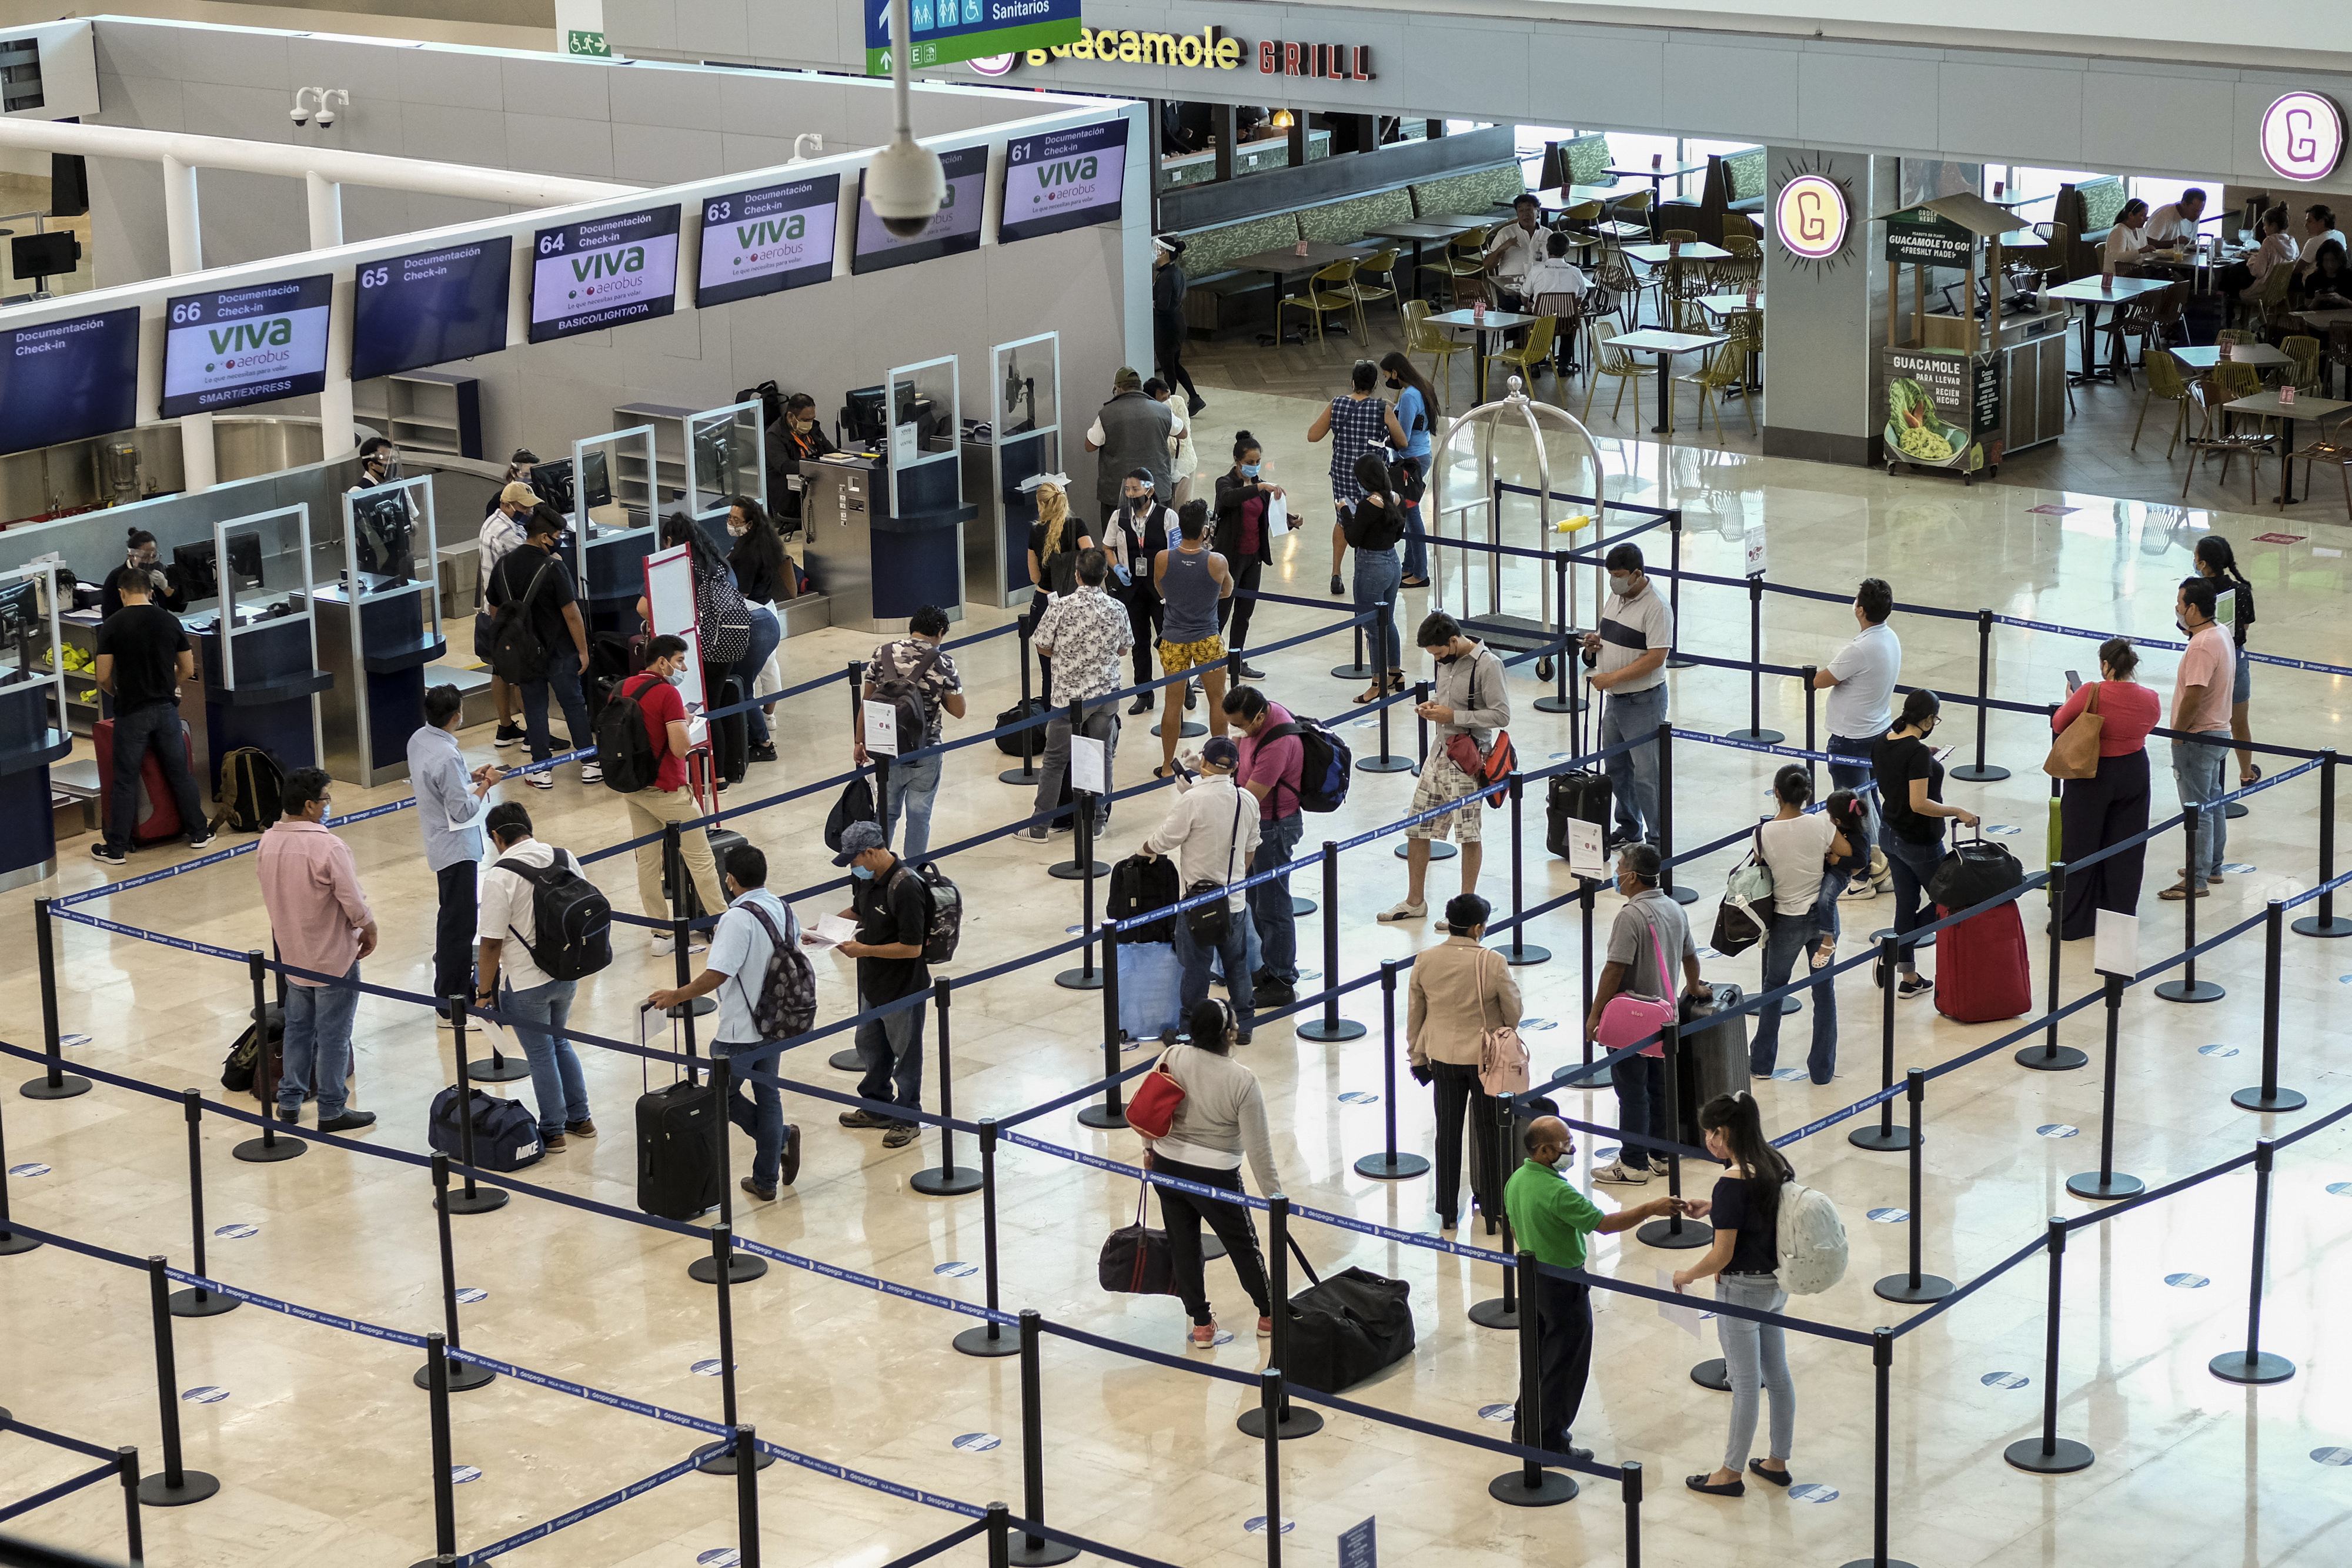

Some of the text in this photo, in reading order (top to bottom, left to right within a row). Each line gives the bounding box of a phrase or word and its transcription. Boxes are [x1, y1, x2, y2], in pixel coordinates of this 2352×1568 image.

[992, 0, 1050, 20] Sanitarios
[1258, 40, 1368, 81] GRILL
[1012, 127, 1104, 161] 61 Documentación
[1044, 144, 1078, 156] Check-in
[1057, 183, 1095, 199] aerobus
[707, 184, 812, 222] 63 Documentación
[744, 202, 782, 215] Check-in
[1048, 201, 1070, 210] necesitas
[540, 215, 652, 254] 64 Documentación
[579, 233, 620, 248] Check-in
[760, 243, 803, 260] aerobus
[1889, 235, 1970, 252] GUACAMOLE TO GO!
[1905, 246, 1952, 259] FRESHLY MADE
[362, 248, 480, 288] 65 Documentación
[403, 266, 447, 281] Check-in
[751, 263, 775, 272] necesitas
[597, 276, 643, 294] aerobus
[173, 285, 300, 323] 66 Documentación
[587, 296, 613, 305] necesitas
[218, 303, 263, 317] Check-in
[559, 304, 649, 330] BASICO/LIGHT/OTA
[16, 320, 104, 342] Documentación
[16, 340, 66, 356] Check-in
[238, 350, 290, 368] aerobus
[1893, 356, 1960, 375] GUACAMOLE
[213, 375, 226, 383] que
[227, 370, 256, 380] necesitas
[1916, 373, 1960, 385] PARA LLEVAR
[199, 380, 292, 404] SMART/EXPRESS
[1936, 388, 1959, 397] RECIÉN
[1937, 396, 1959, 405] HECHO
[515, 1140, 539, 1161] NIKE
[1308, 1210, 1334, 1222] despegar
[1384, 1229, 1410, 1241] despegar
[1459, 1246, 1486, 1258] despegar
